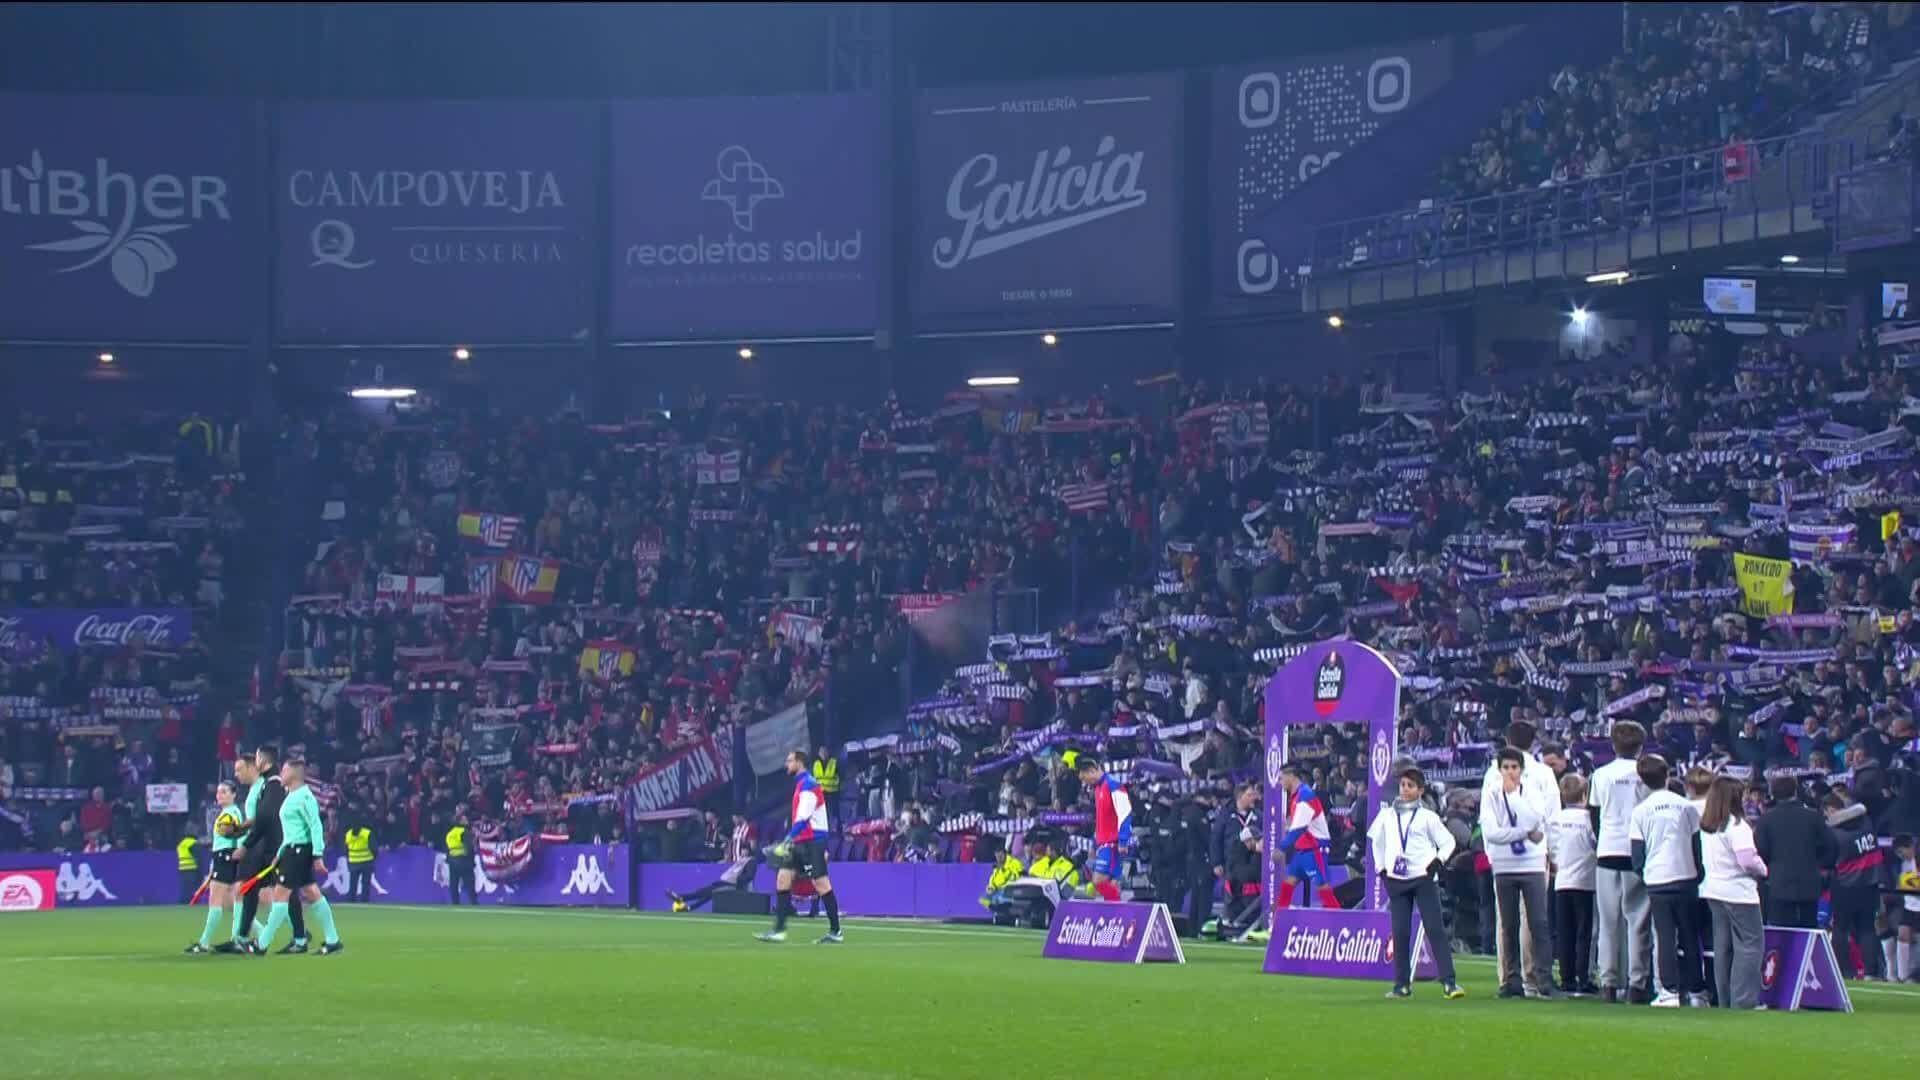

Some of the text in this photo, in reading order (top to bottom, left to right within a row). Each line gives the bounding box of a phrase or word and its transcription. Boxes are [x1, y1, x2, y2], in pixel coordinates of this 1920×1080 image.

[289, 168, 566, 214] CAMPOVEJA
[932, 133, 1147, 269] Galicia
[626, 229, 862, 265] recoletas salud
[1855, 833, 1876, 854] 142
[4, 884, 33, 898] EA
[1057, 915, 1094, 945] Estrella
[1283, 925, 1382, 963] Estrella Galicia
